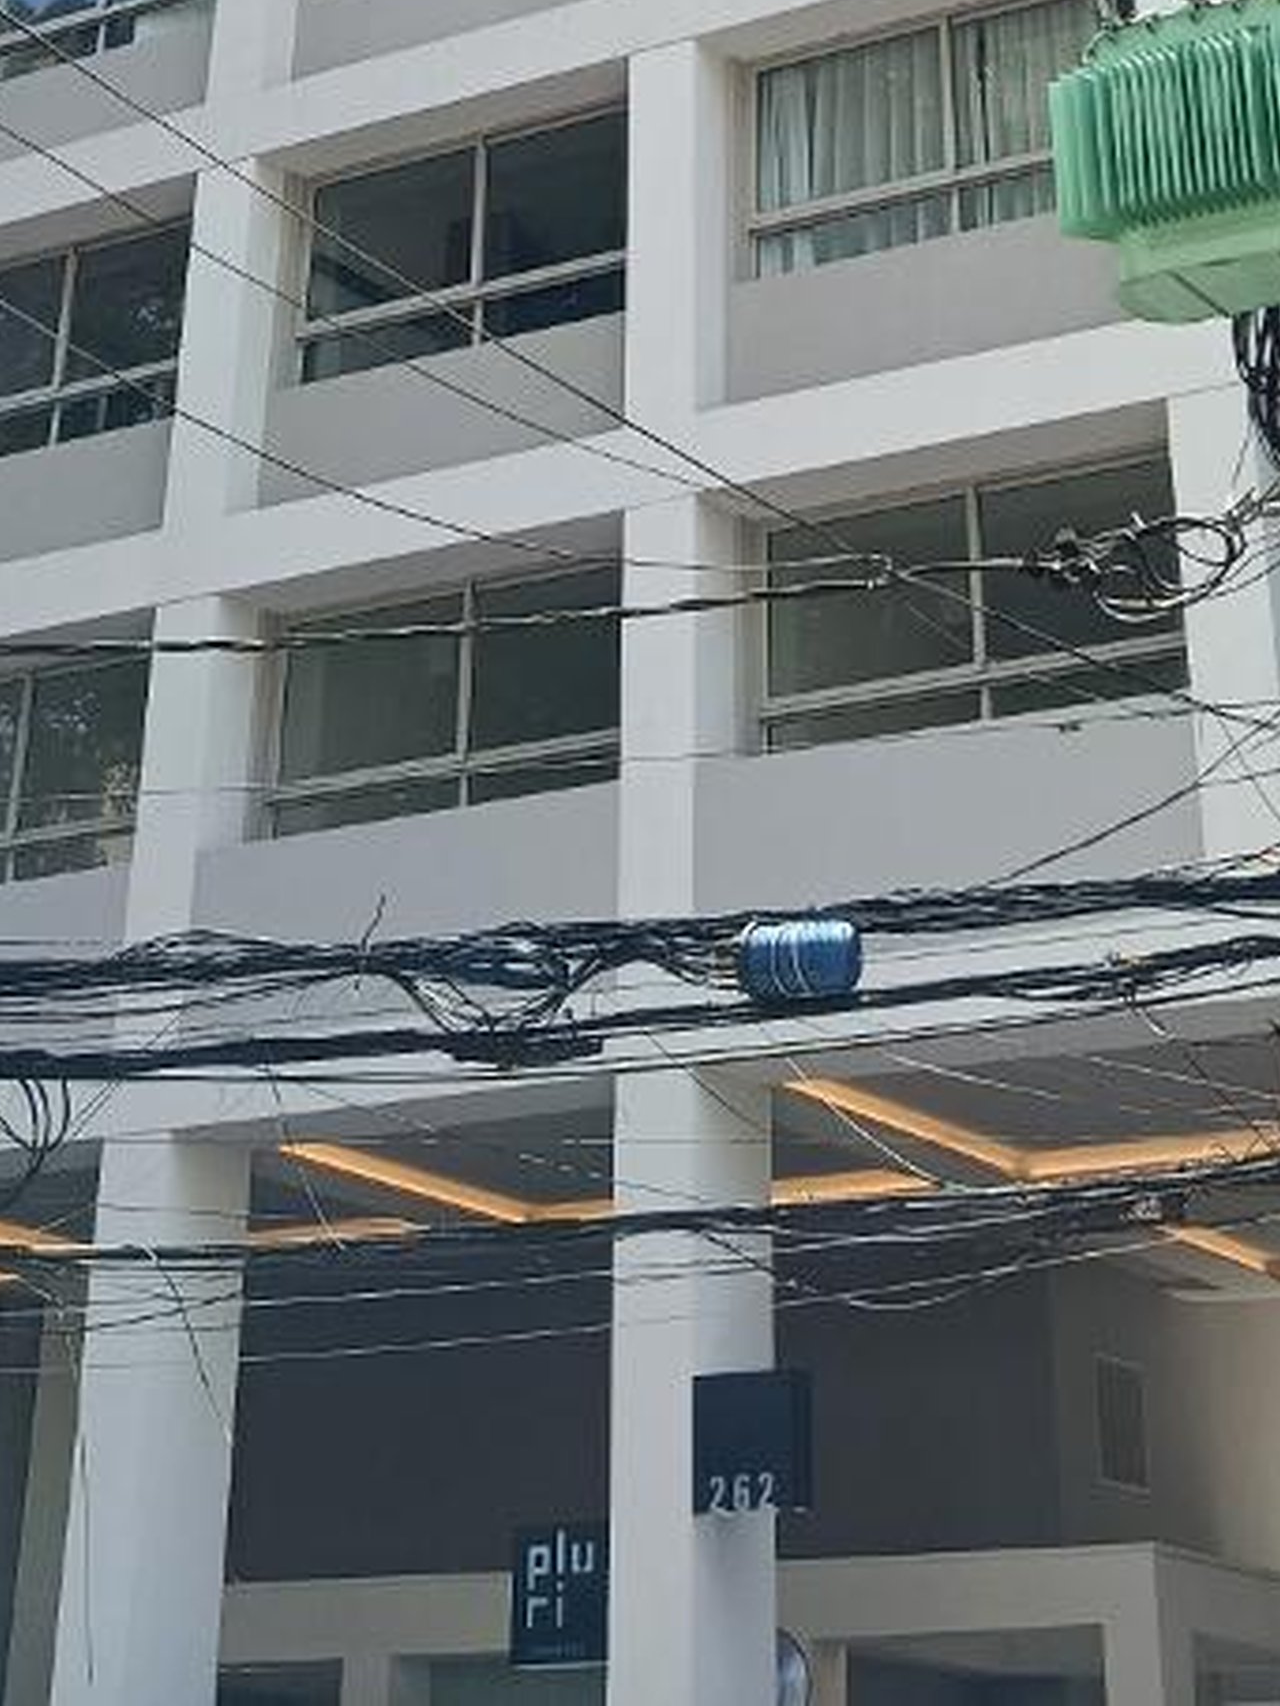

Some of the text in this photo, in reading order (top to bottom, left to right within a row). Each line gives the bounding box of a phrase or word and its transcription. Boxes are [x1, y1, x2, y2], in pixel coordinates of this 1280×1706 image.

[710, 1472, 777, 1514] 262
[528, 1528, 594, 1590] plu
[527, 1581, 563, 1628] ri
